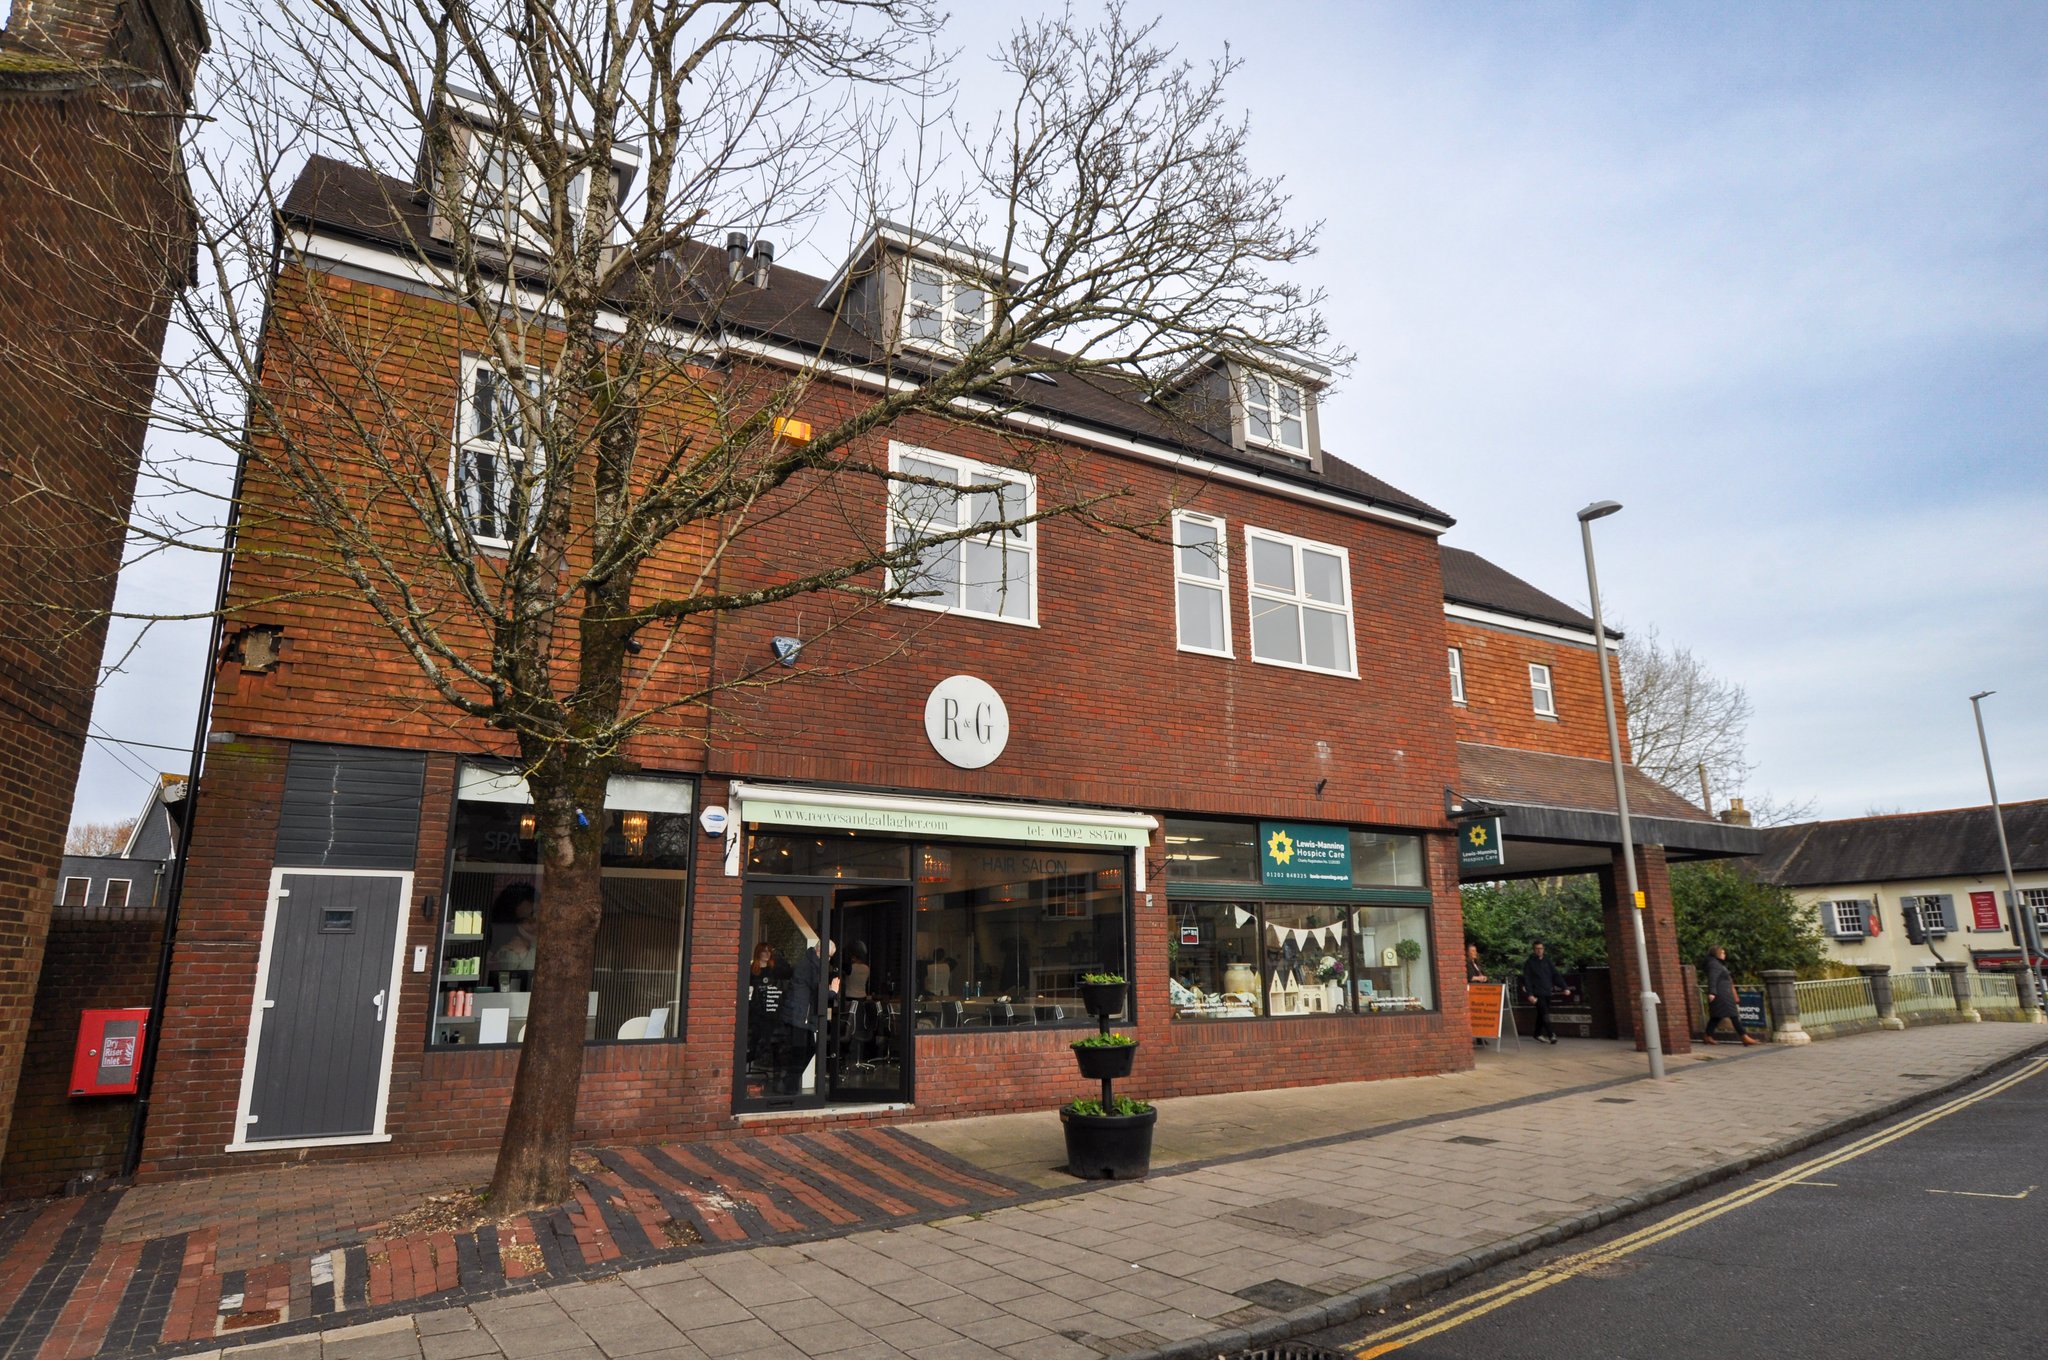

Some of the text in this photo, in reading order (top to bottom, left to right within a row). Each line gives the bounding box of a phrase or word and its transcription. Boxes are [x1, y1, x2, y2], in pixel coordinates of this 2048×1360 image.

[940, 697, 963, 742] R
[975, 701, 994, 744] G
[773, 809, 948, 831] www.reevesandgallagher.com
[1027, 825, 1127, 841] tel: 01202 884700
[484, 831, 521, 852] SPA
[1296, 840, 1344, 851] Lewis-Manning
[1297, 848, 1345, 859] Hospice Care
[1462, 849, 1498, 857] Lewis-Manning
[982, 856, 1067, 875] HAIR SALON
[106, 1040, 119, 1049] Dry
[105, 1048, 123, 1057] Riser
[104, 1056, 120, 1065] Inlet
